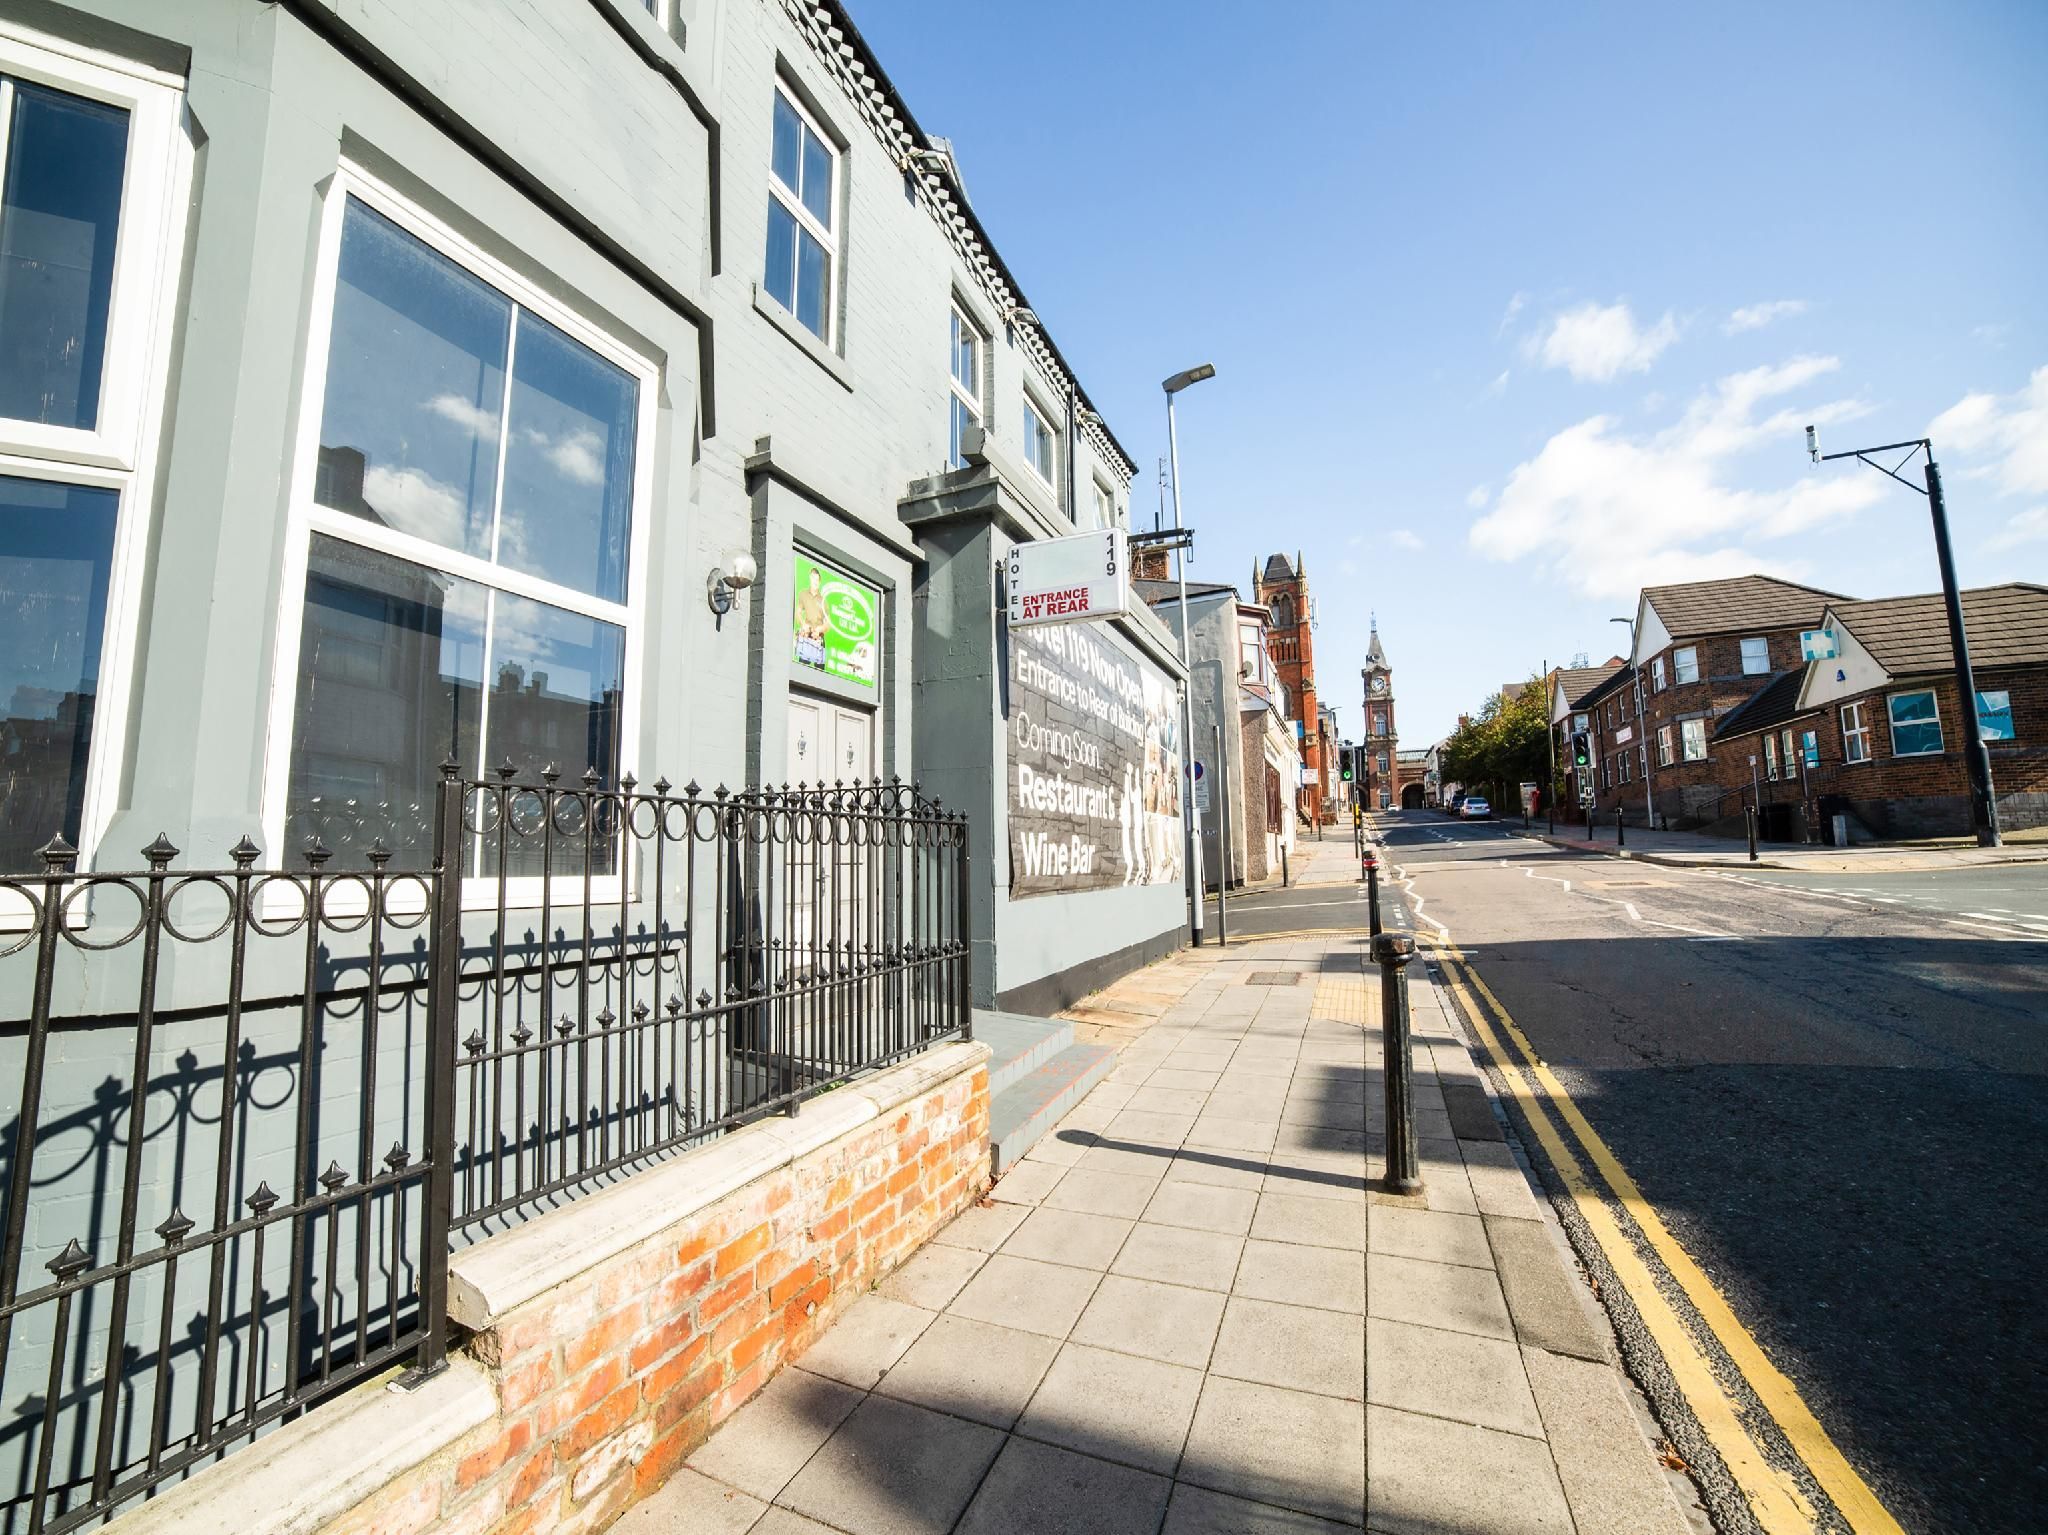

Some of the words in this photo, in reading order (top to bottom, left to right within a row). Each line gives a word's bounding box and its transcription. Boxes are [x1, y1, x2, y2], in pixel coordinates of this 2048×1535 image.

[1106, 533, 1117, 577] 119
[1010, 549, 1020, 621] HOTEL
[1022, 587, 1089, 607] ENTRANCE
[1022, 605, 1042, 620] AT
[1046, 598, 1090, 616] REAR
[1017, 648, 1076, 705] Entrance
[1077, 681, 1089, 711] to
[1089, 686, 1110, 721] Rear
[1110, 701, 1118, 727] of
[1028, 624, 1066, 658] otel
[1066, 626, 1090, 673] 119
[1089, 641, 1116, 692] Now
[1116, 663, 1143, 709] Open
[1016, 711, 1071, 770] Coming
[1018, 763, 1107, 819] Restaurant
[1020, 831, 1068, 876] Wine
[1071, 834, 1096, 874] Bar
